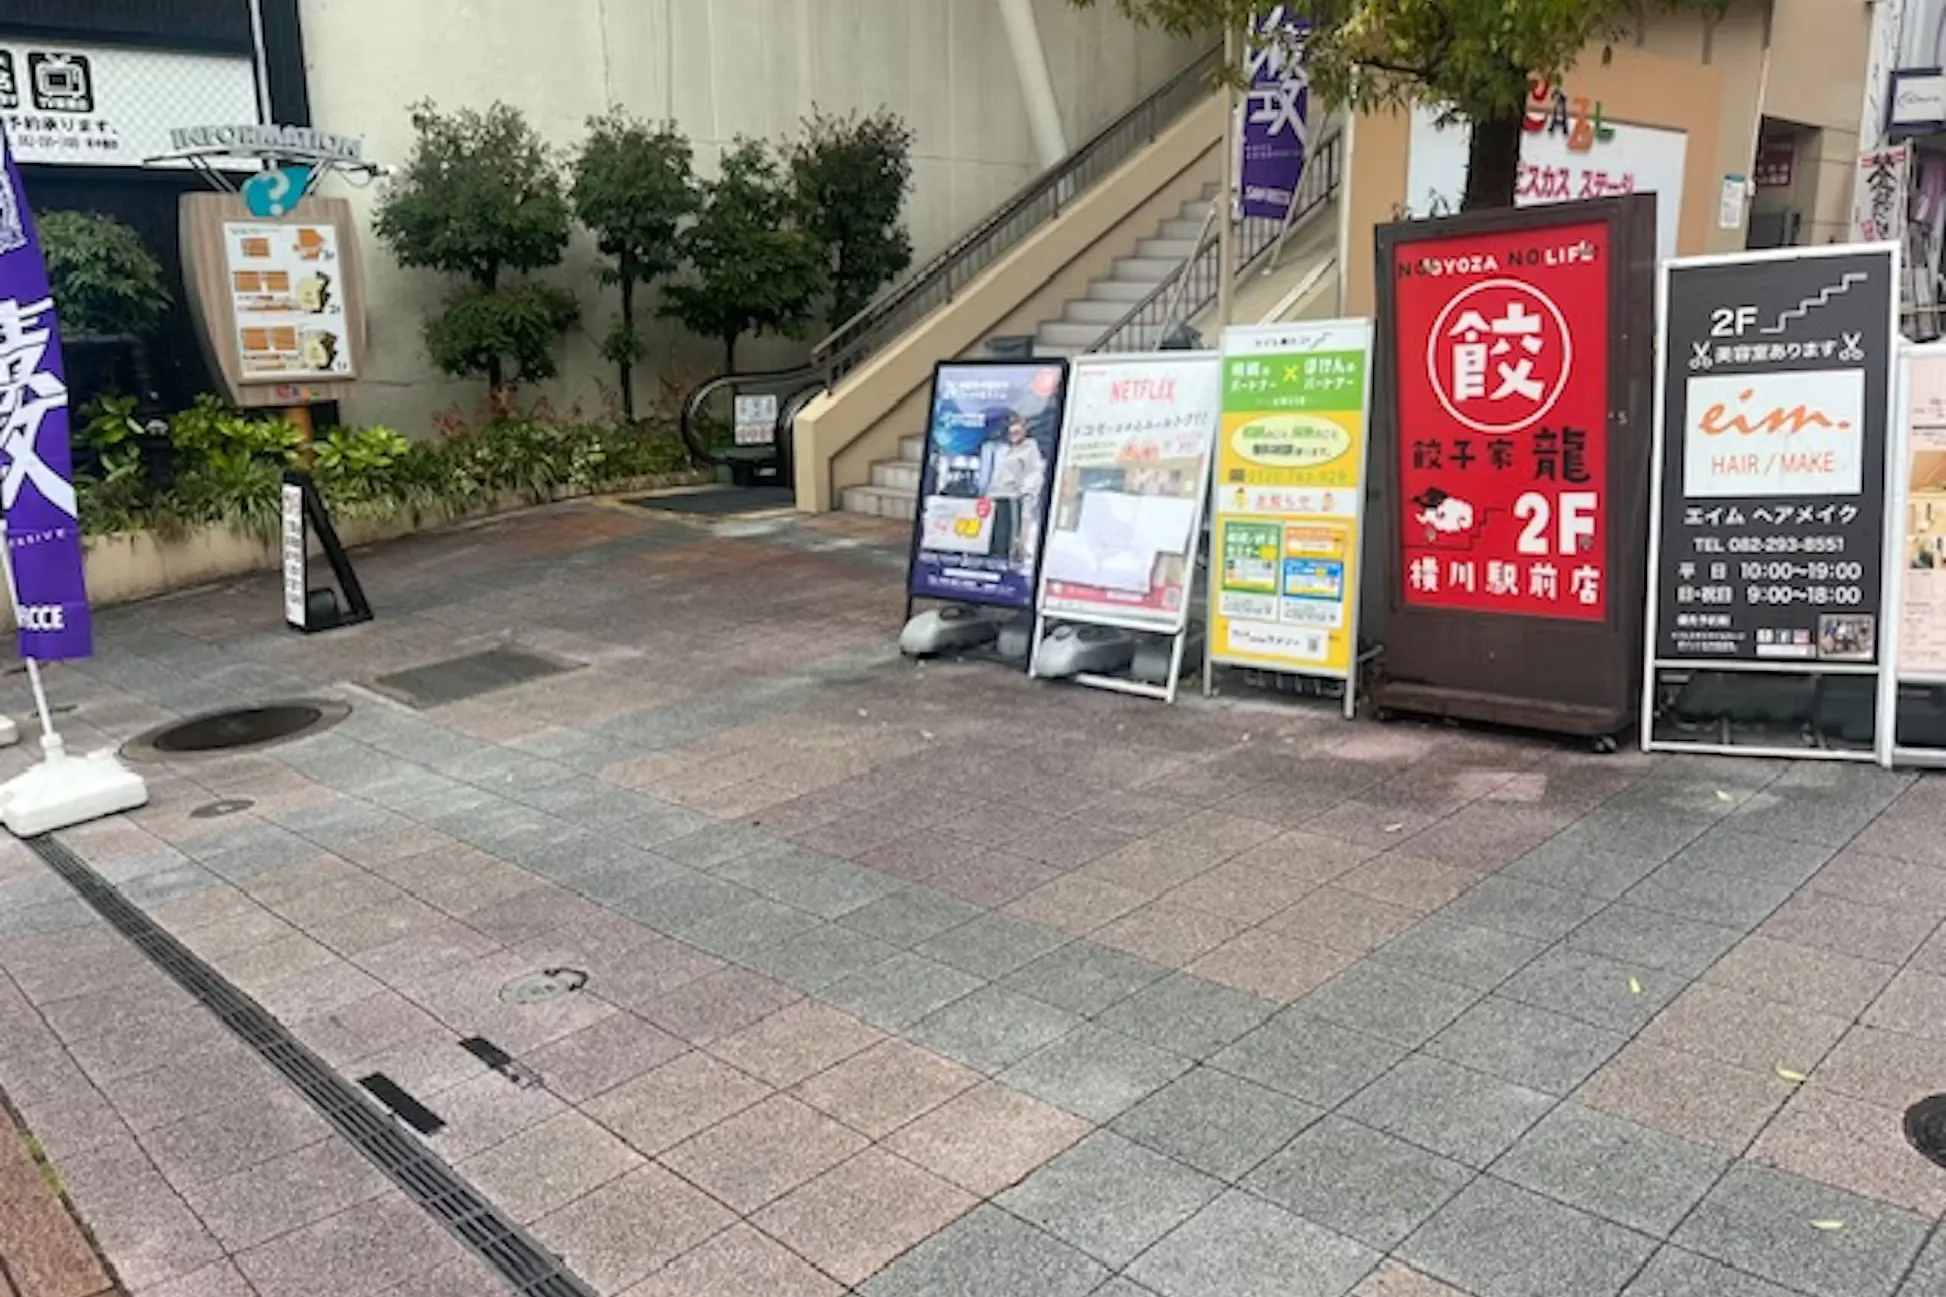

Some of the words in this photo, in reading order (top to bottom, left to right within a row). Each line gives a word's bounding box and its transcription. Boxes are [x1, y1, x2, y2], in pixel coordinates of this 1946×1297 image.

[170, 124, 363, 157] INFORMATION
[1507, 248, 1540, 267] NO
[1711, 306, 1758, 337] 2F
[1448, 301, 1547, 402] 餃
[1714, 340, 1838, 364] 美容室あります
[1110, 378, 1178, 404] NETFLIX
[1513, 491, 1599, 556] 2F
[1684, 506, 1746, 527] エイム
[1752, 503, 1858, 526] ヘアメイク
[1693, 537, 1726, 553] TEL
[1408, 556, 1600, 605] 横川駅前店
